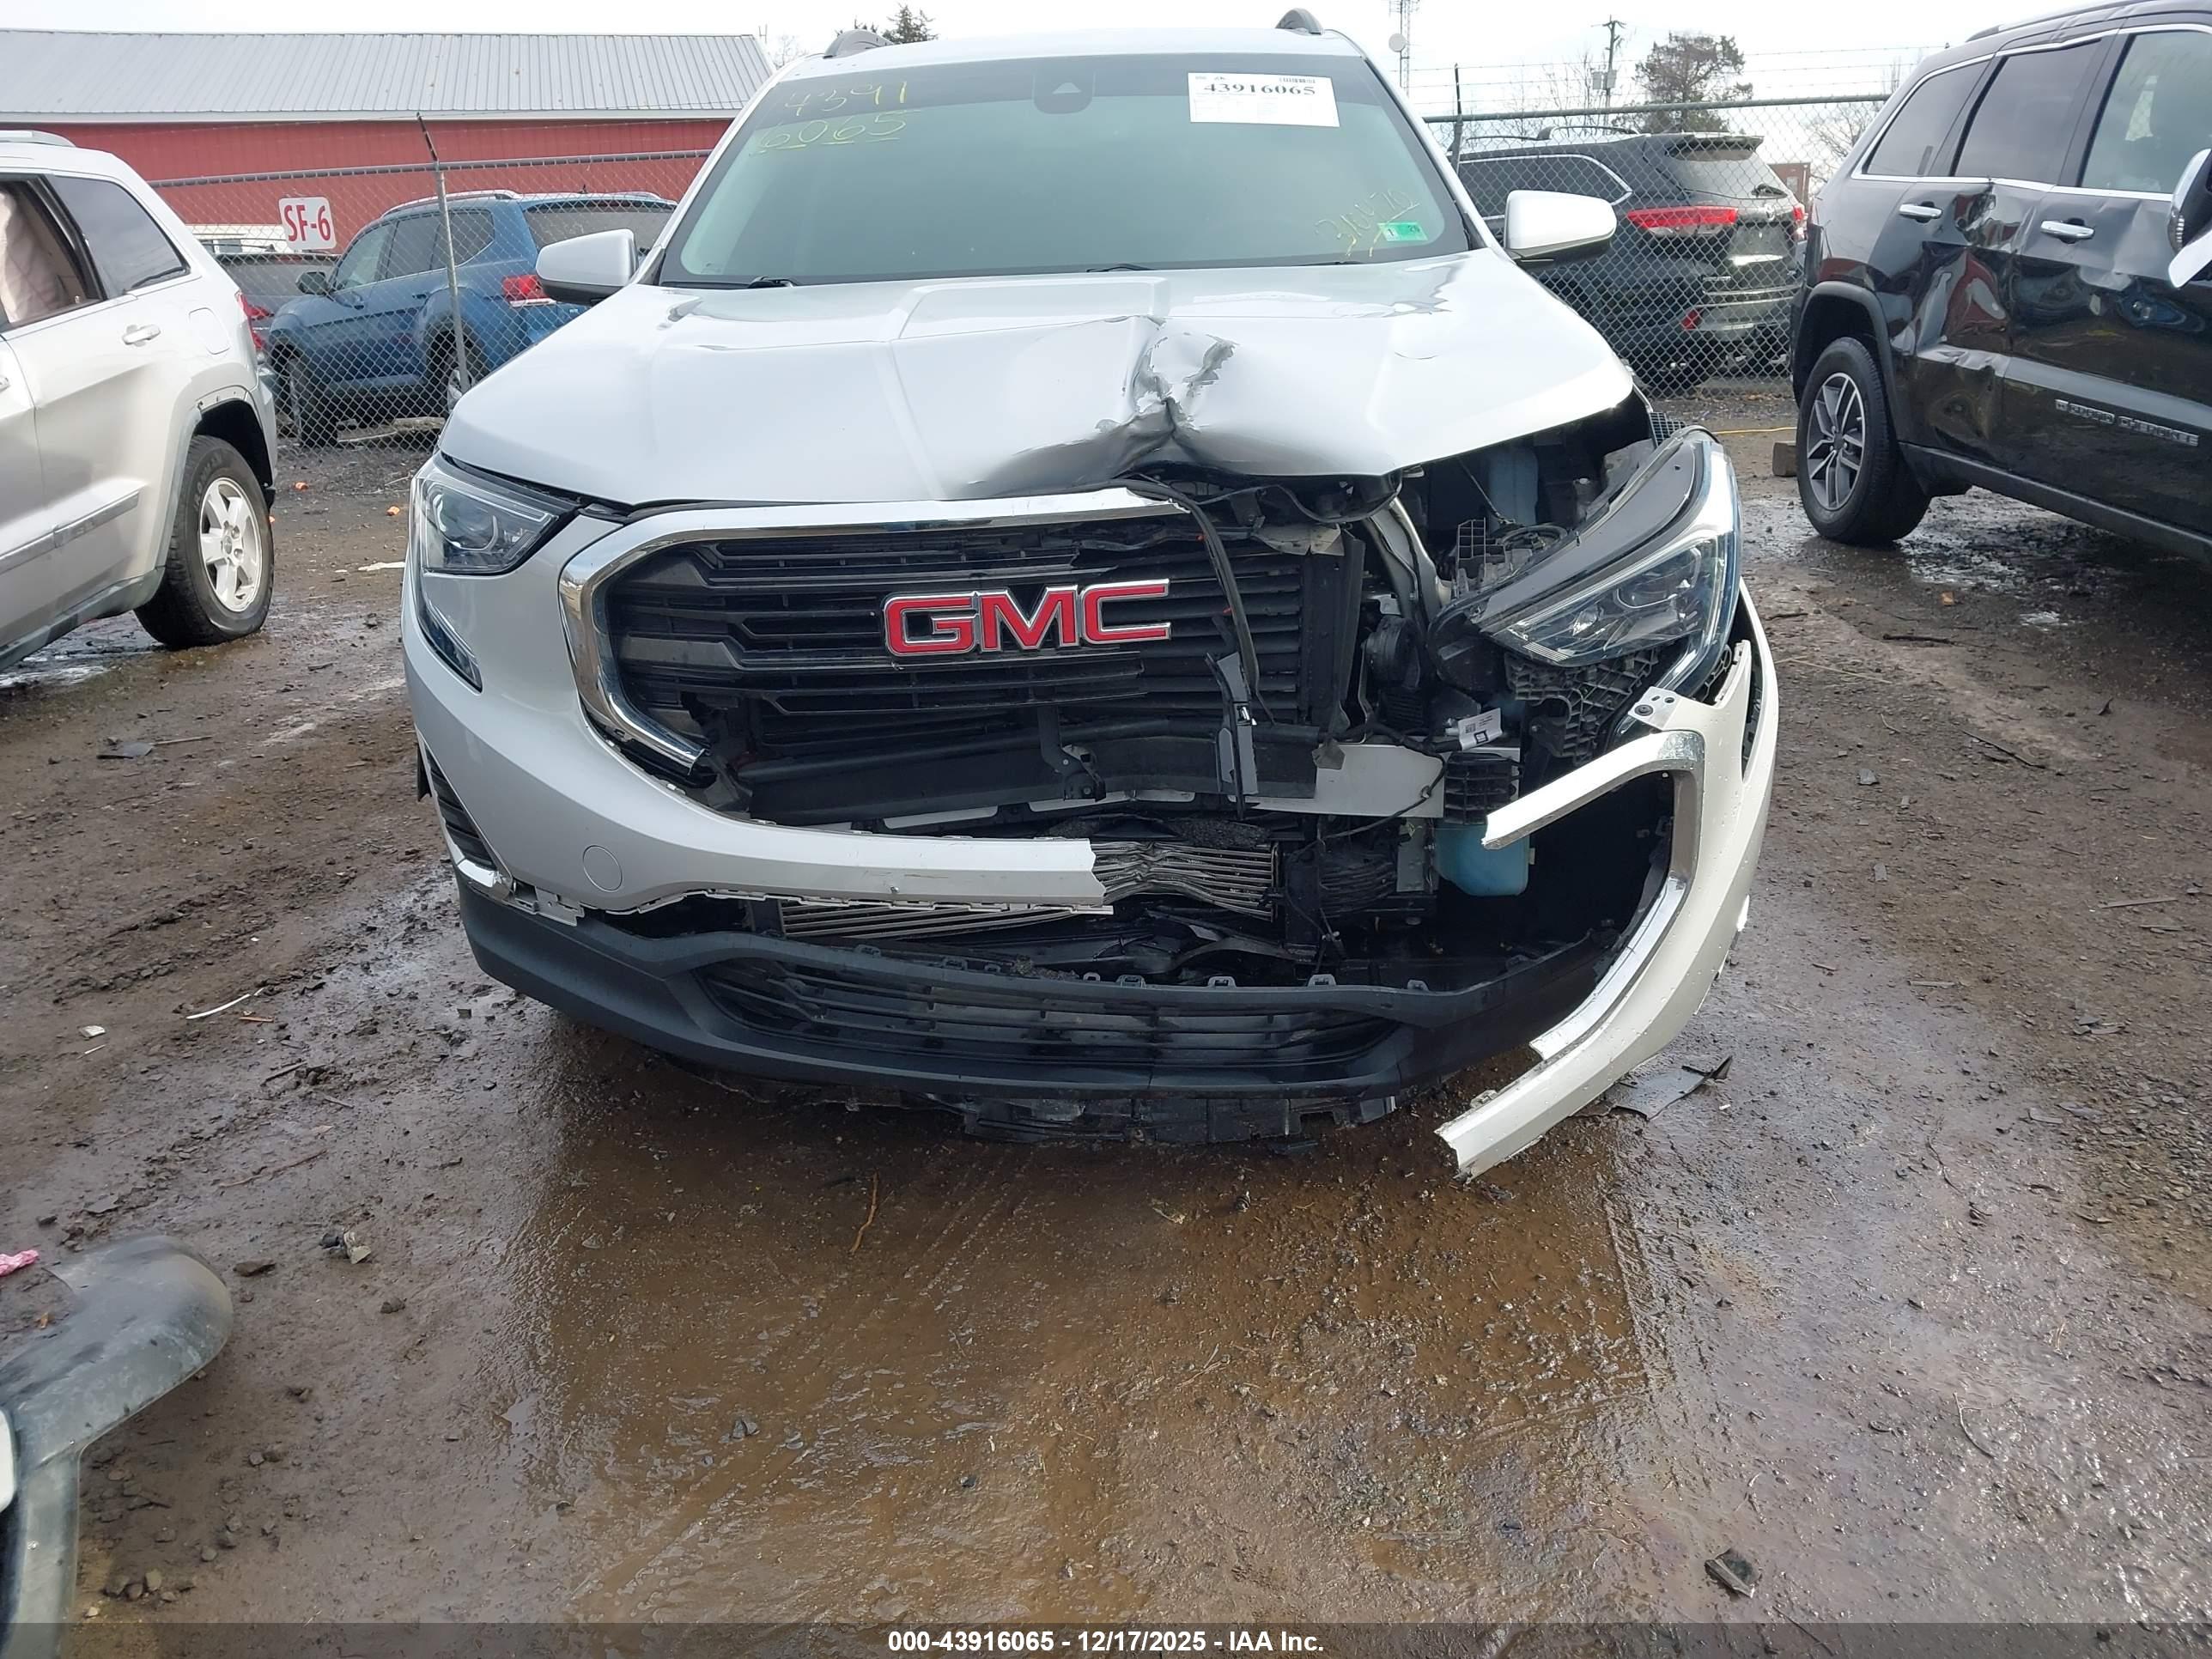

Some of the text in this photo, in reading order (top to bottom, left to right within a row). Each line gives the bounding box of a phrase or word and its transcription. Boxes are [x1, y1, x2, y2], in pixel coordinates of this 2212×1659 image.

[1204, 83, 1316, 96] 43916065
[760, 109, 921, 149] 6065
[283, 204, 331, 242] SF-6
[883, 578, 1171, 657] GMC
